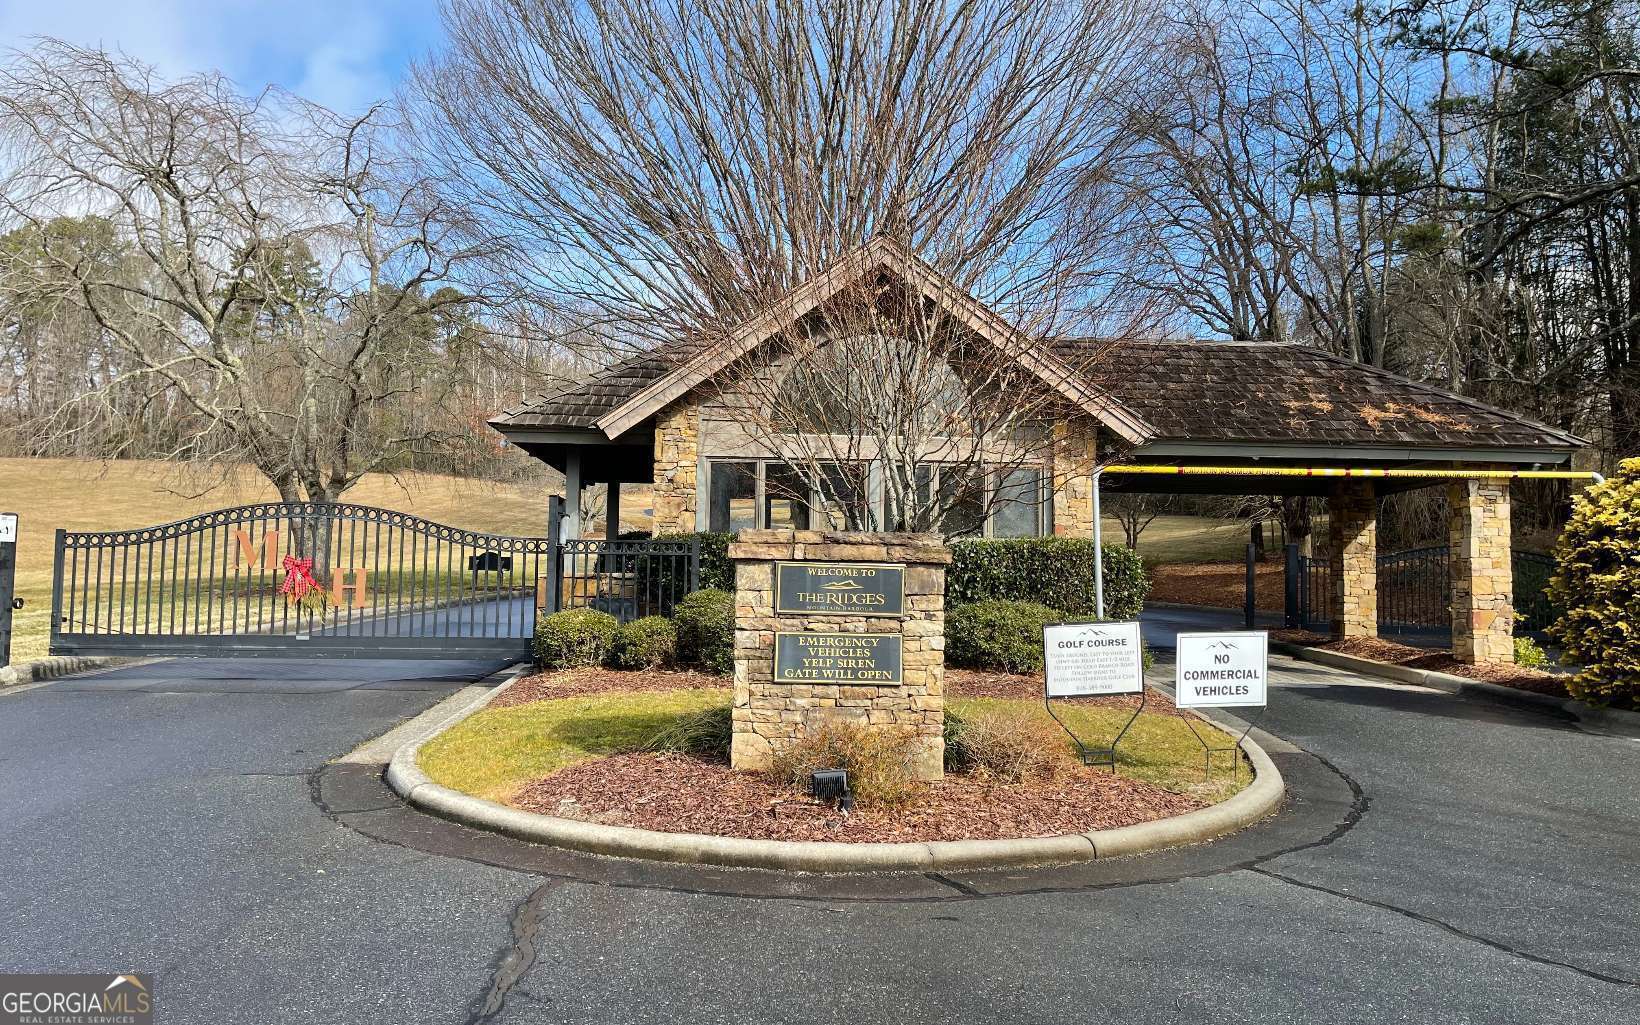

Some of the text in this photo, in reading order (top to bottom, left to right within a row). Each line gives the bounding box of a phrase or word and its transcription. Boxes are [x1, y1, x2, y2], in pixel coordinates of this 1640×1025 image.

[232, 529, 283, 570] M
[807, 567, 876, 577] WELCOME TO
[331, 567, 369, 609] H
[797, 592, 885, 606] THE RIDGES
[799, 636, 880, 647] EMERGENCY
[1058, 638, 1128, 649] GOLF COURSE
[808, 648, 871, 657] VEHICLES
[803, 659, 875, 668] YELP SIREN
[1214, 654, 1230, 664] NO
[784, 669, 892, 680] GATE WILL OPEN
[1183, 669, 1260, 681] COMMERCIAL
[1194, 685, 1249, 696] VEHICLES
